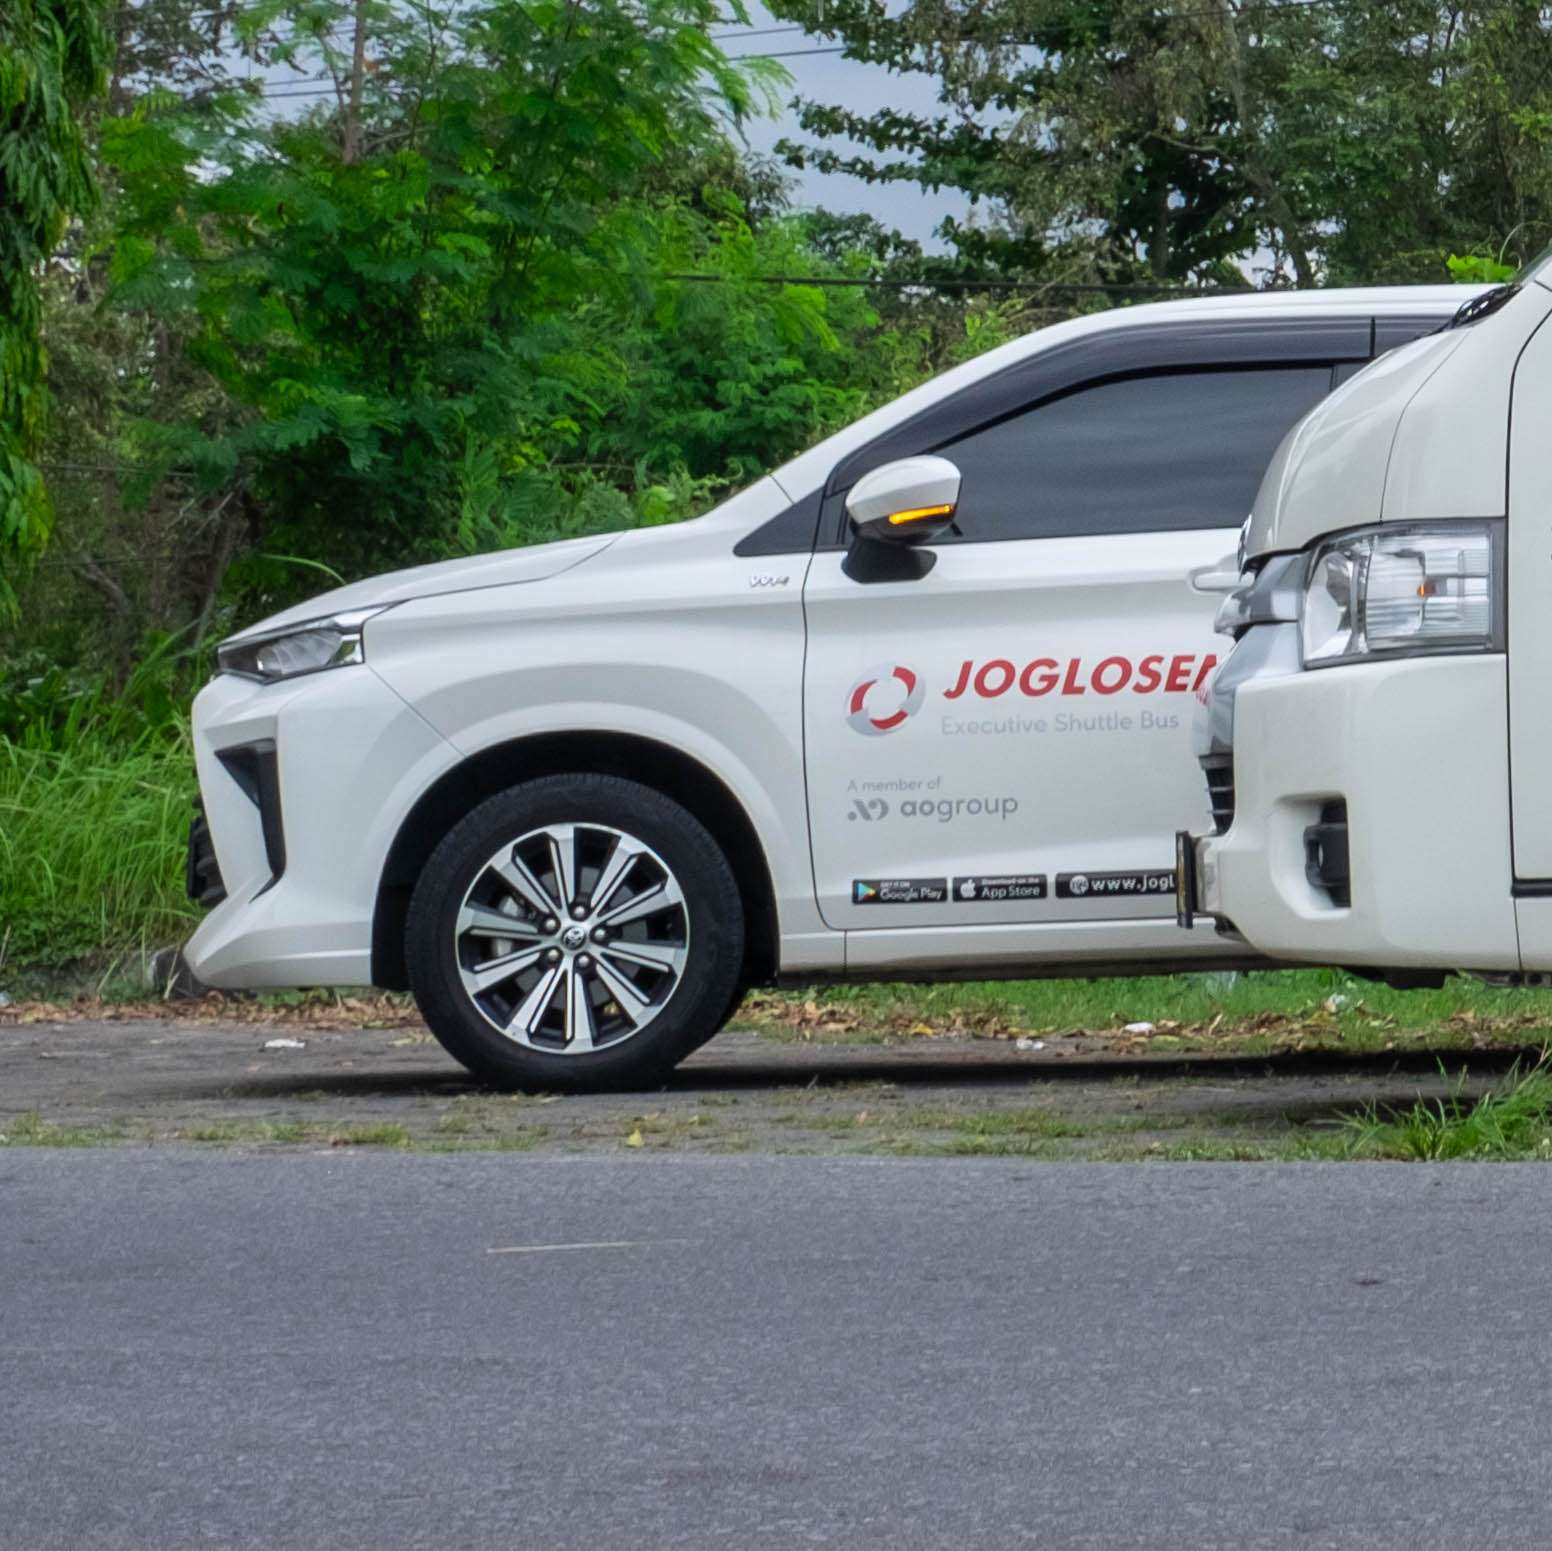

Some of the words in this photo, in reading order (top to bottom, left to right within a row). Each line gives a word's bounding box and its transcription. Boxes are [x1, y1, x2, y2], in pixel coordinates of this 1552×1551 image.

[940, 713, 1048, 736] Executive
[1054, 710, 1133, 733] Shuttle
[1140, 709, 1181, 731] Bus
[846, 778, 860, 794] A
[862, 778, 922, 793] member
[925, 774, 943, 791] of
[900, 794, 1018, 822] aogroup
[920, 887, 942, 901] Play
[981, 886, 1007, 900] App
[1008, 885, 1041, 898] Store
